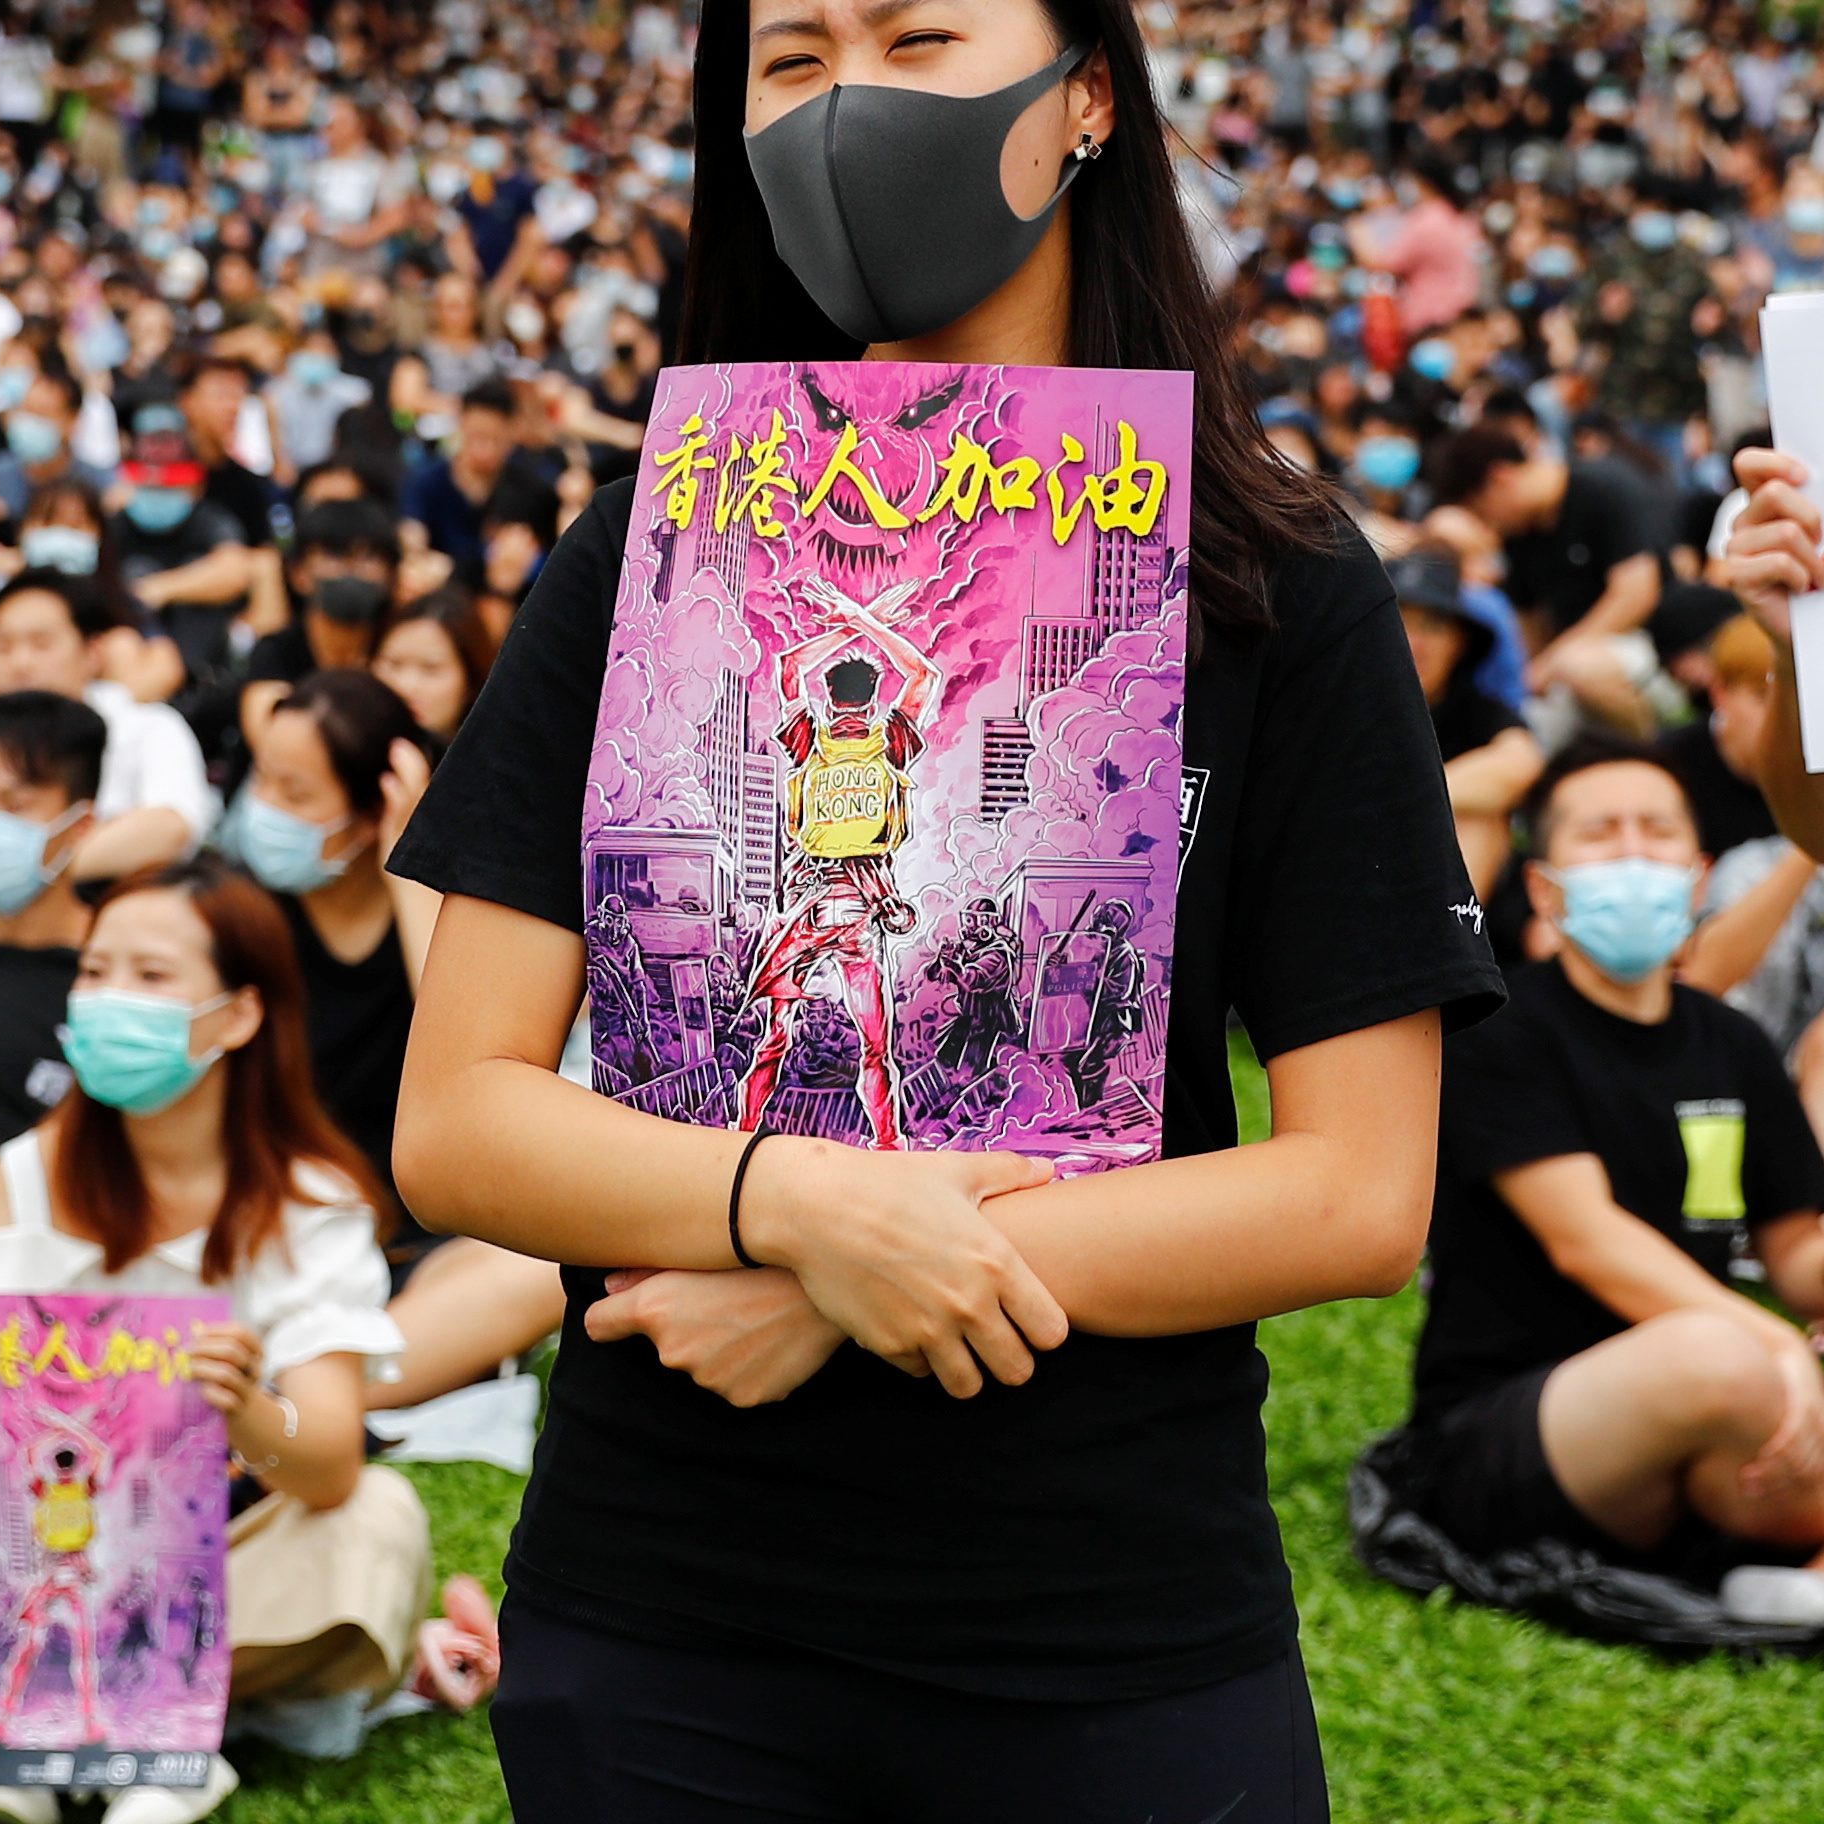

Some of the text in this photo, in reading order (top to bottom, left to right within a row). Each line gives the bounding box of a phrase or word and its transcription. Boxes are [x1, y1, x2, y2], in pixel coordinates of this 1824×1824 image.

[649, 409, 1168, 545] 香港人加油
[817, 766, 880, 794] HONG
[817, 794, 881, 819] KONG
